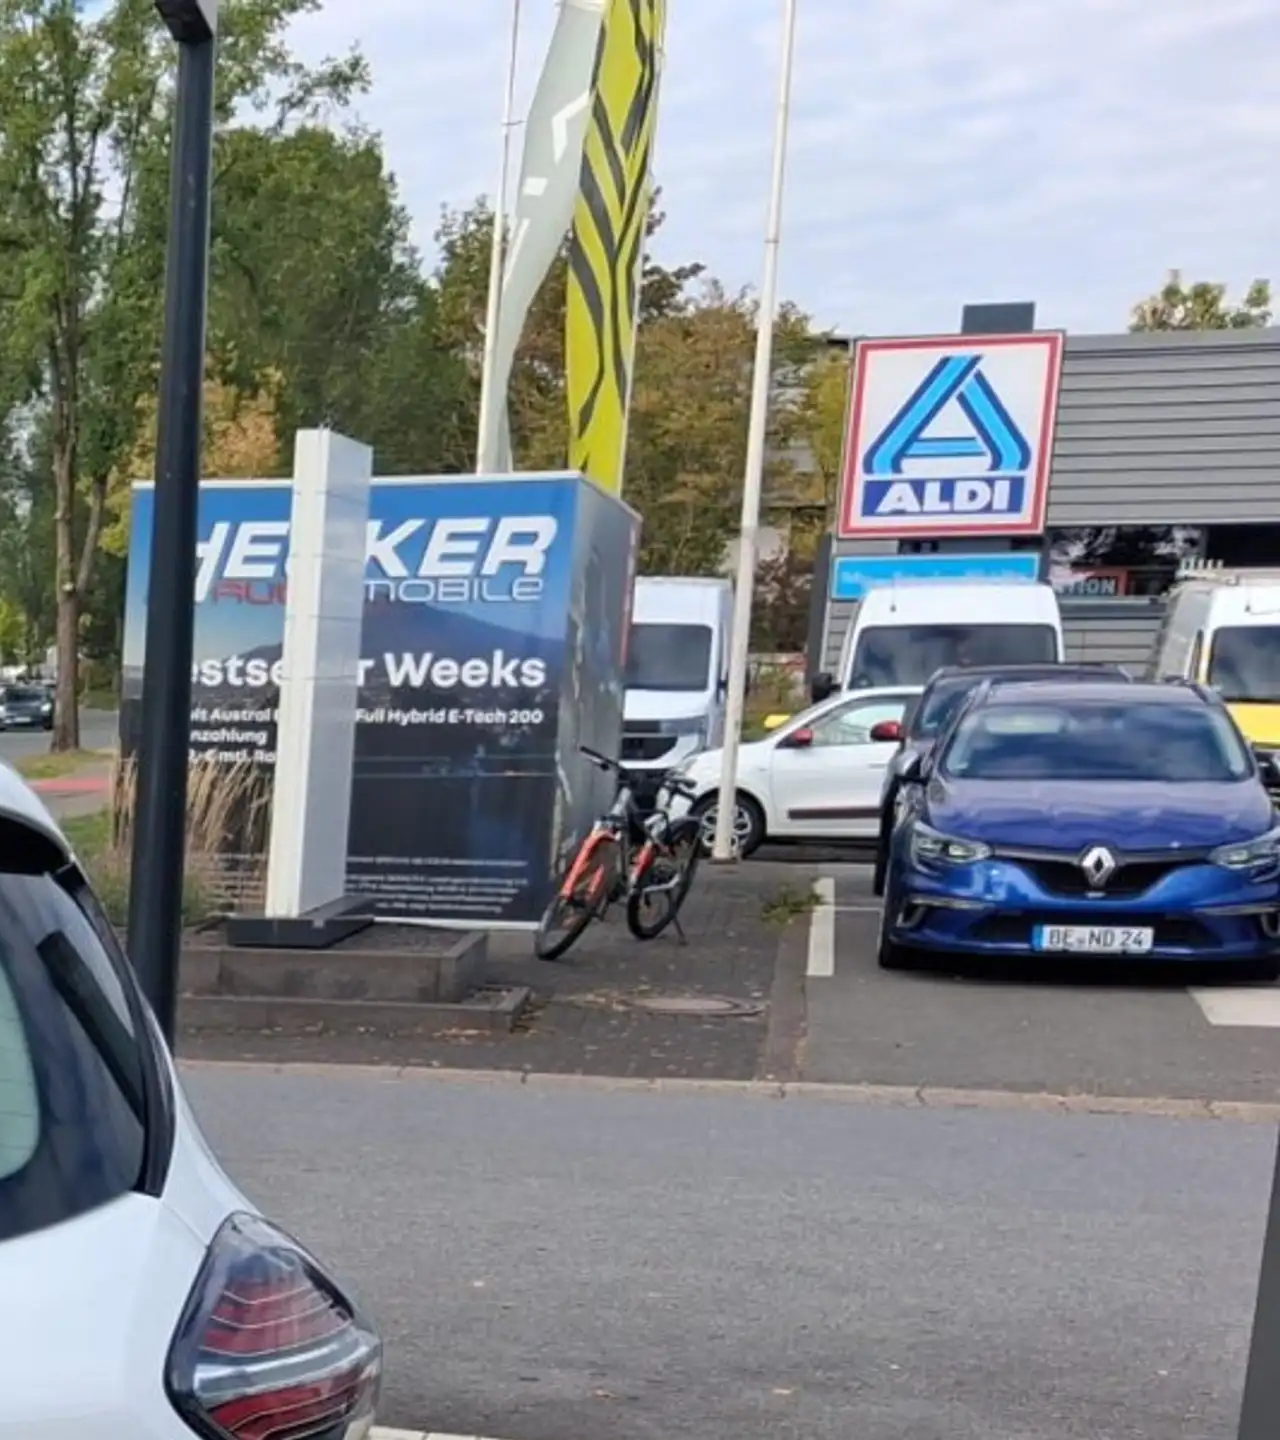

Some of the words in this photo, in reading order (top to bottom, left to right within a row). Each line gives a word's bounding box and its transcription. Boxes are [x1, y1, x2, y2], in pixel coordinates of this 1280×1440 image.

[874, 480, 1011, 513] ALDI
[195, 515, 558, 603] HEKER
[384, 649, 547, 688] Weeks
[210, 707, 271, 722] Austral
[355, 708, 384, 723] Full
[388, 708, 446, 726] Hybrid
[448, 708, 507, 724] E-Tech
[509, 709, 545, 725] 200
[190, 728, 268, 746] nzahlung
